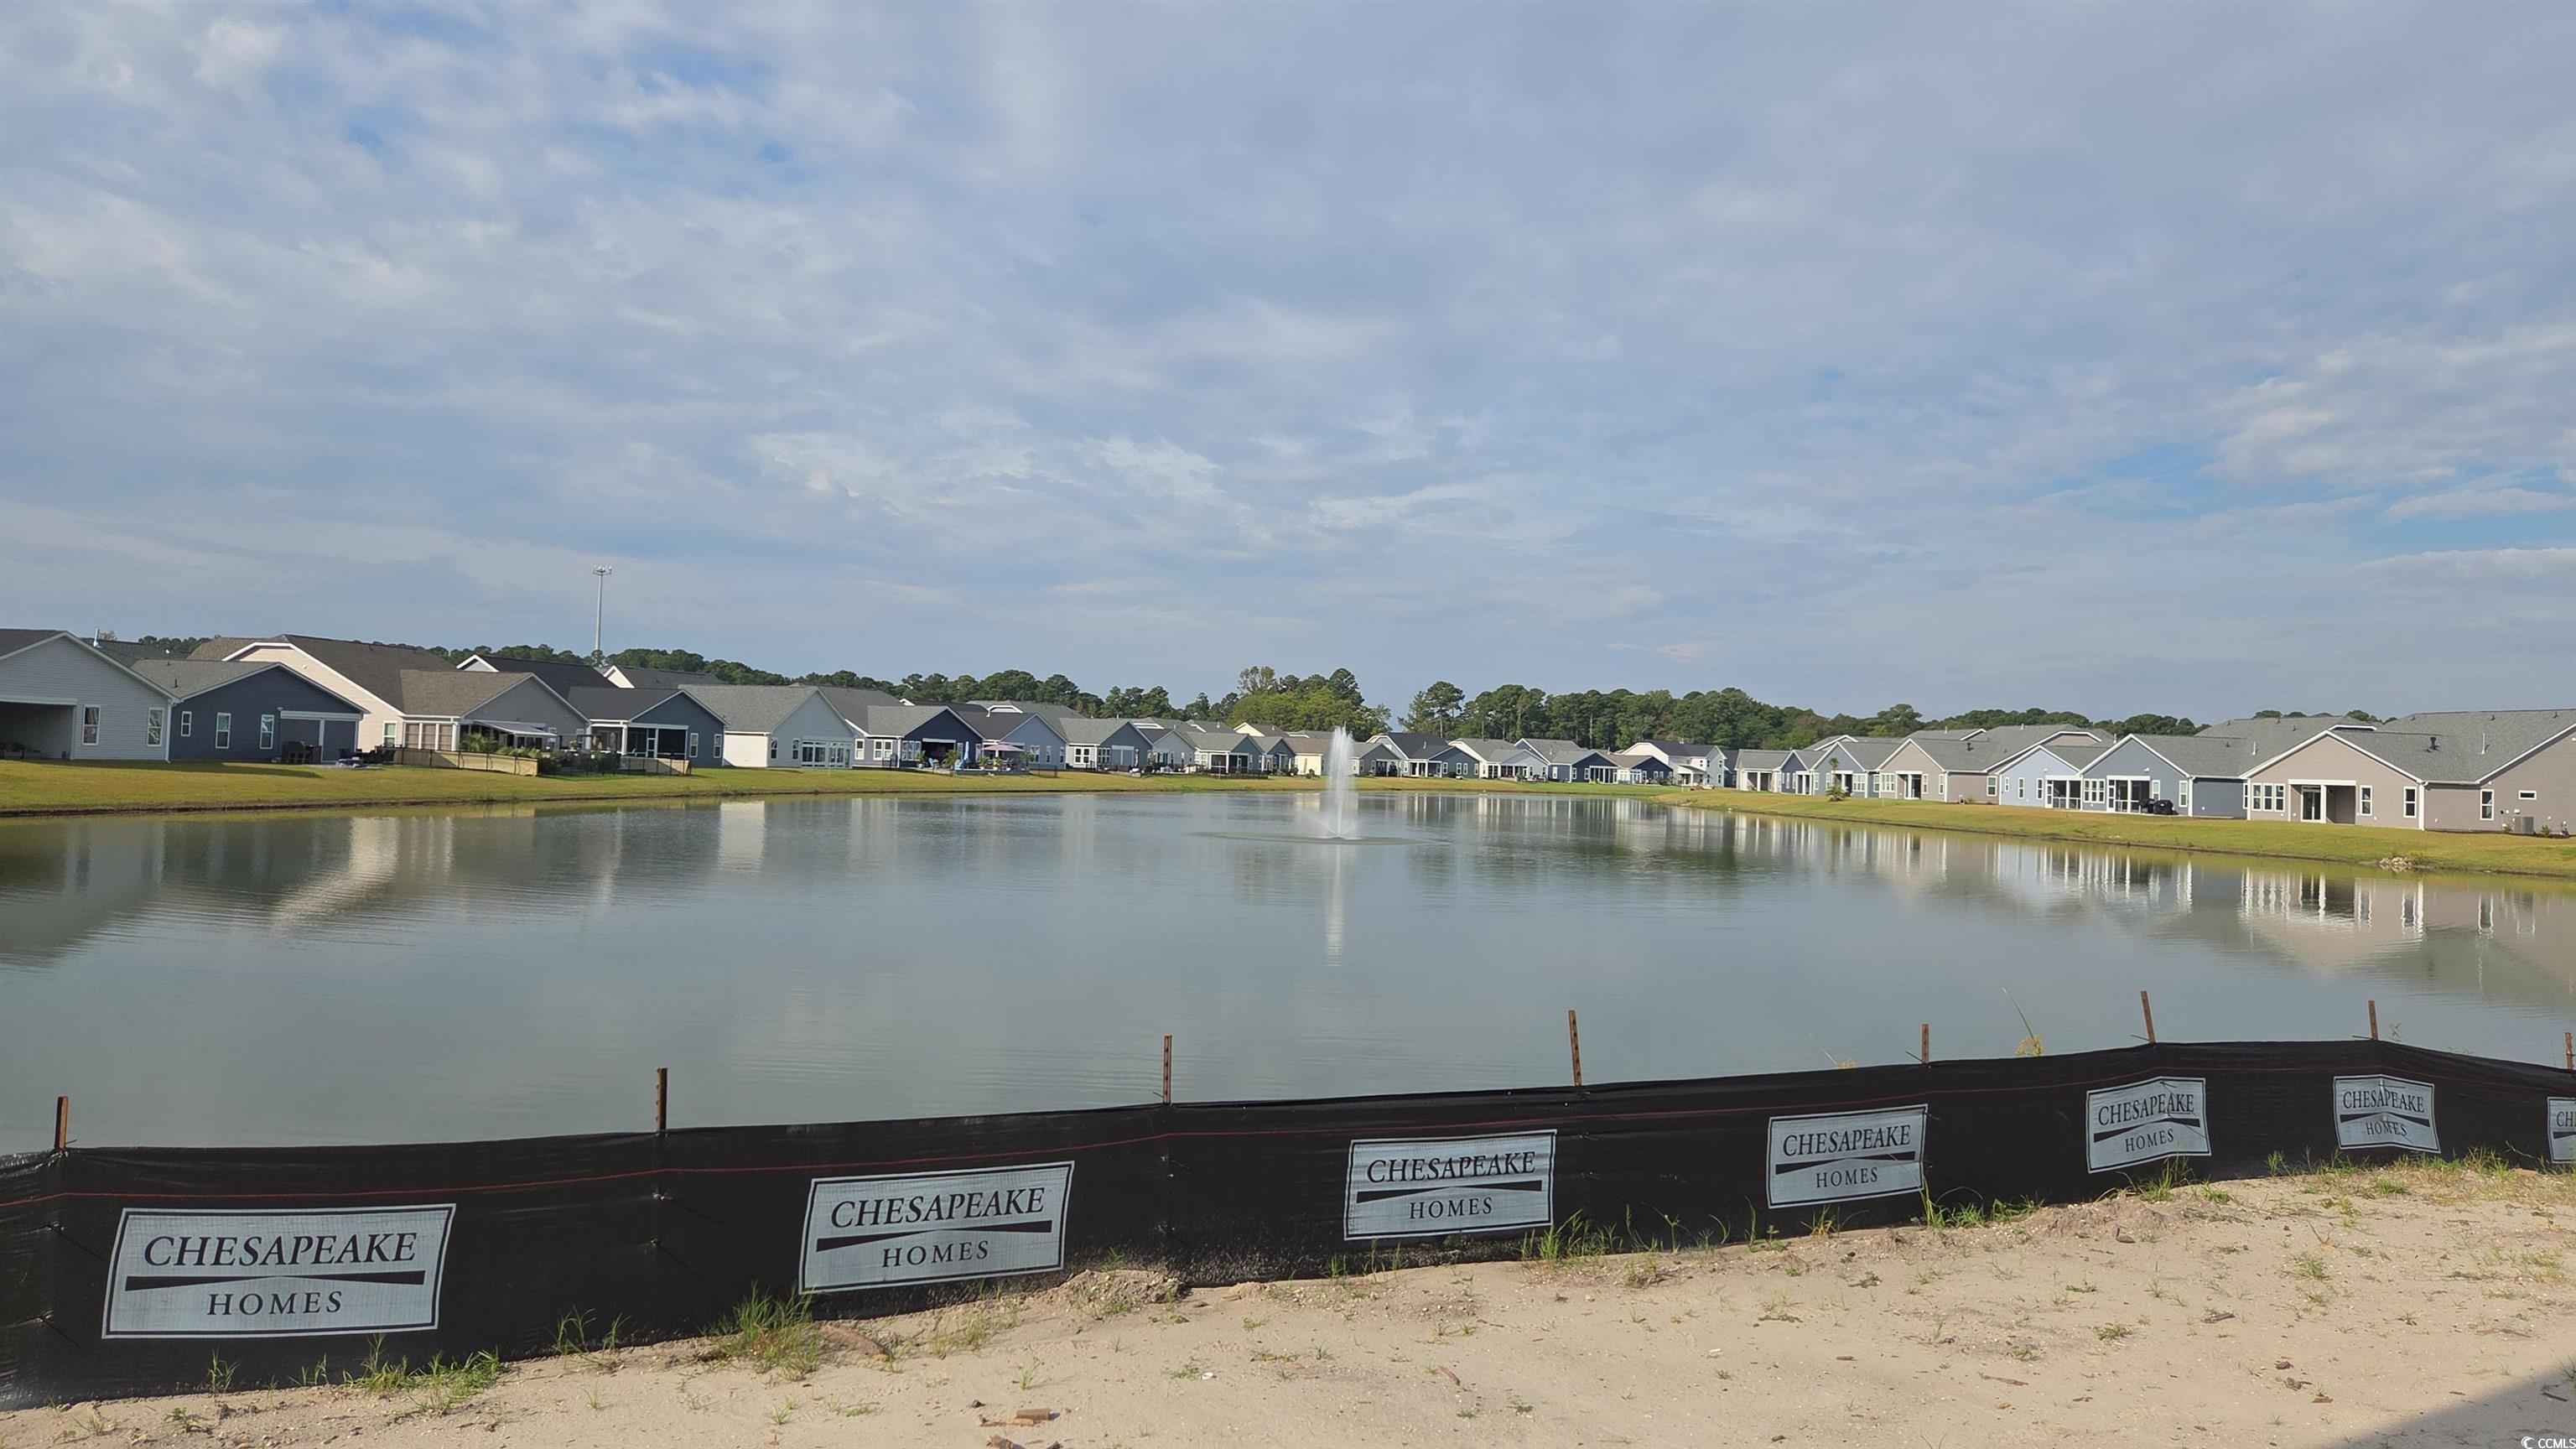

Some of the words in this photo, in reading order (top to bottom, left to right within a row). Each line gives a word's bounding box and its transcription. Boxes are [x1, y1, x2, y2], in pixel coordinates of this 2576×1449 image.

[2098, 1093, 2194, 1126] CHESAPEAKE
[2342, 1089, 2425, 1114] CHESAPEAKE
[2365, 1121, 2407, 1136] HOMES
[2557, 1111, 2576, 1127] CH
[1783, 1124, 1911, 1157] CHESAPEAKE
[2124, 1128, 2174, 1153] HOMES
[1367, 1150, 1536, 1184] CHESAPEAKE
[1815, 1166, 1878, 1188] HOMES
[831, 1187, 1045, 1228] CHESAPEAKE
[1409, 1197, 1493, 1219] HOMES
[143, 1232, 418, 1266] CHESAPEAKE
[881, 1240, 989, 1268] HOMES
[207, 1291, 343, 1316] HOMES
